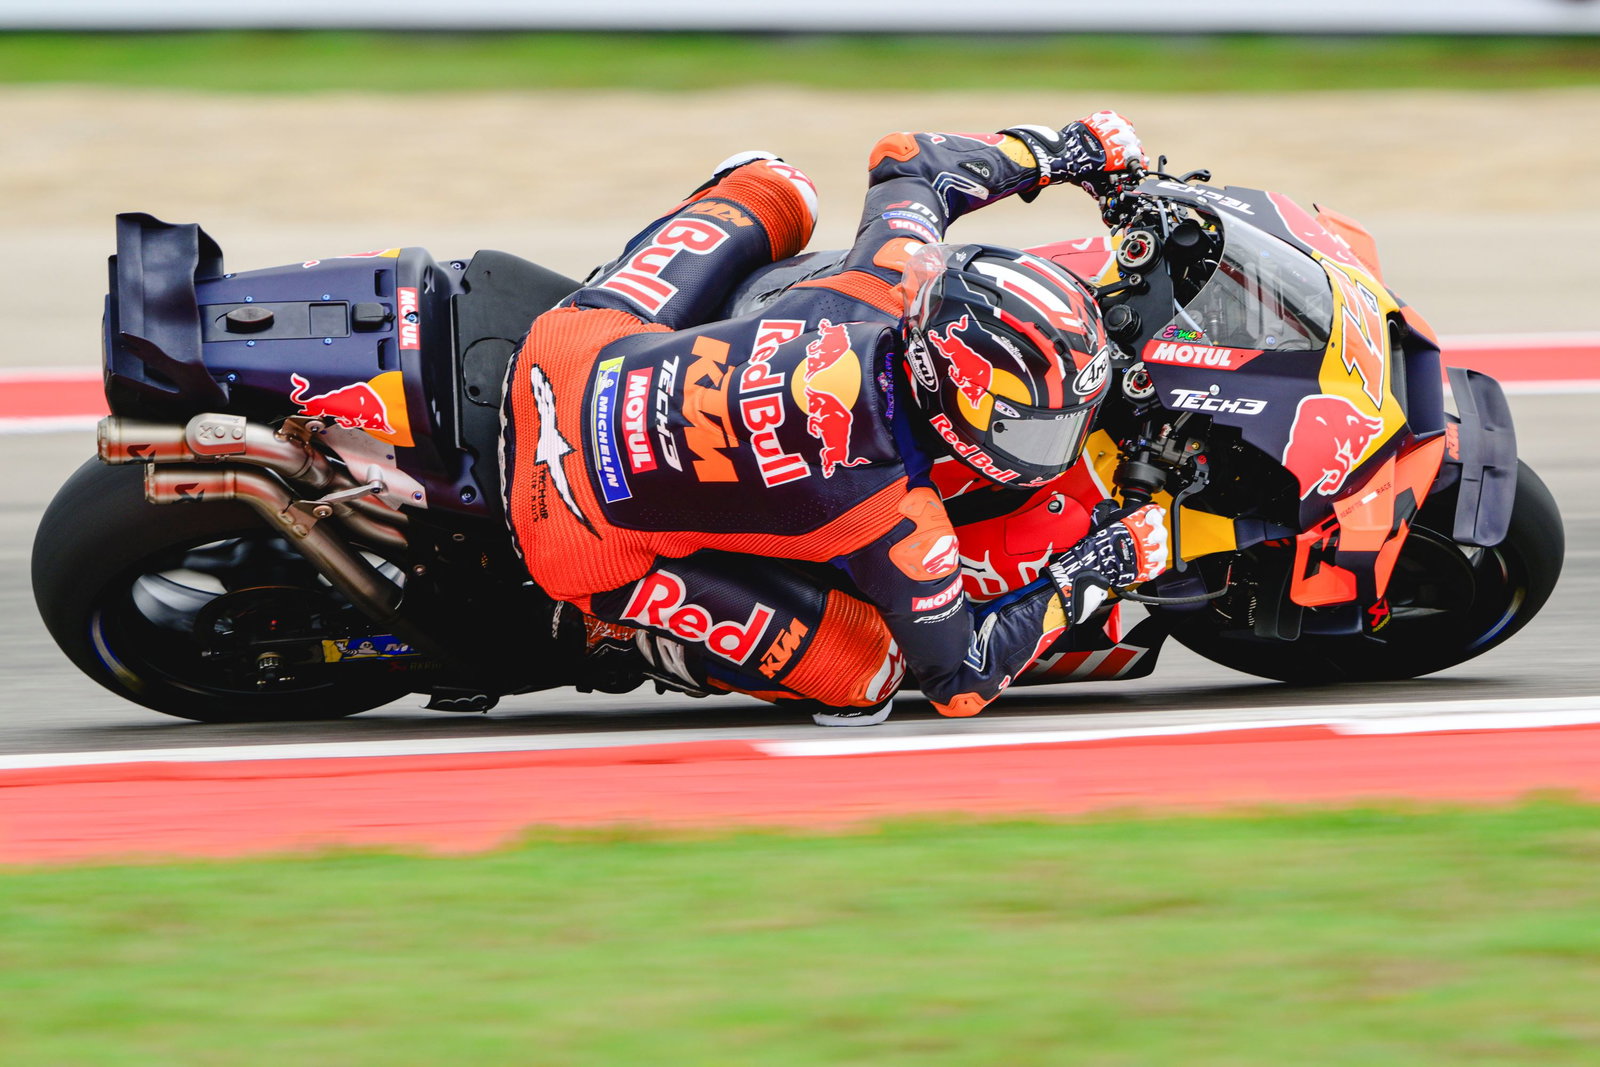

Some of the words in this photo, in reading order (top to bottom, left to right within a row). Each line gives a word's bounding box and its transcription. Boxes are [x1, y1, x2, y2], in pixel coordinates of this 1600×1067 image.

[598, 217, 730, 316] Bull
[739, 320, 806, 394] Red
[913, 338, 936, 384] Arai
[1152, 343, 1232, 366] MOTUL
[598, 395, 620, 488] MICHELIN
[625, 374, 652, 469] MOTUL
[656, 356, 683, 472] TECH3
[682, 335, 740, 482] KTM
[739, 392, 812, 488] Bull
[929, 413, 981, 458] Red
[966, 448, 1021, 483] Bull
[1170, 389, 1268, 415] TECH3
[620, 569, 775, 665] Red
[758, 617, 809, 679] KTM
